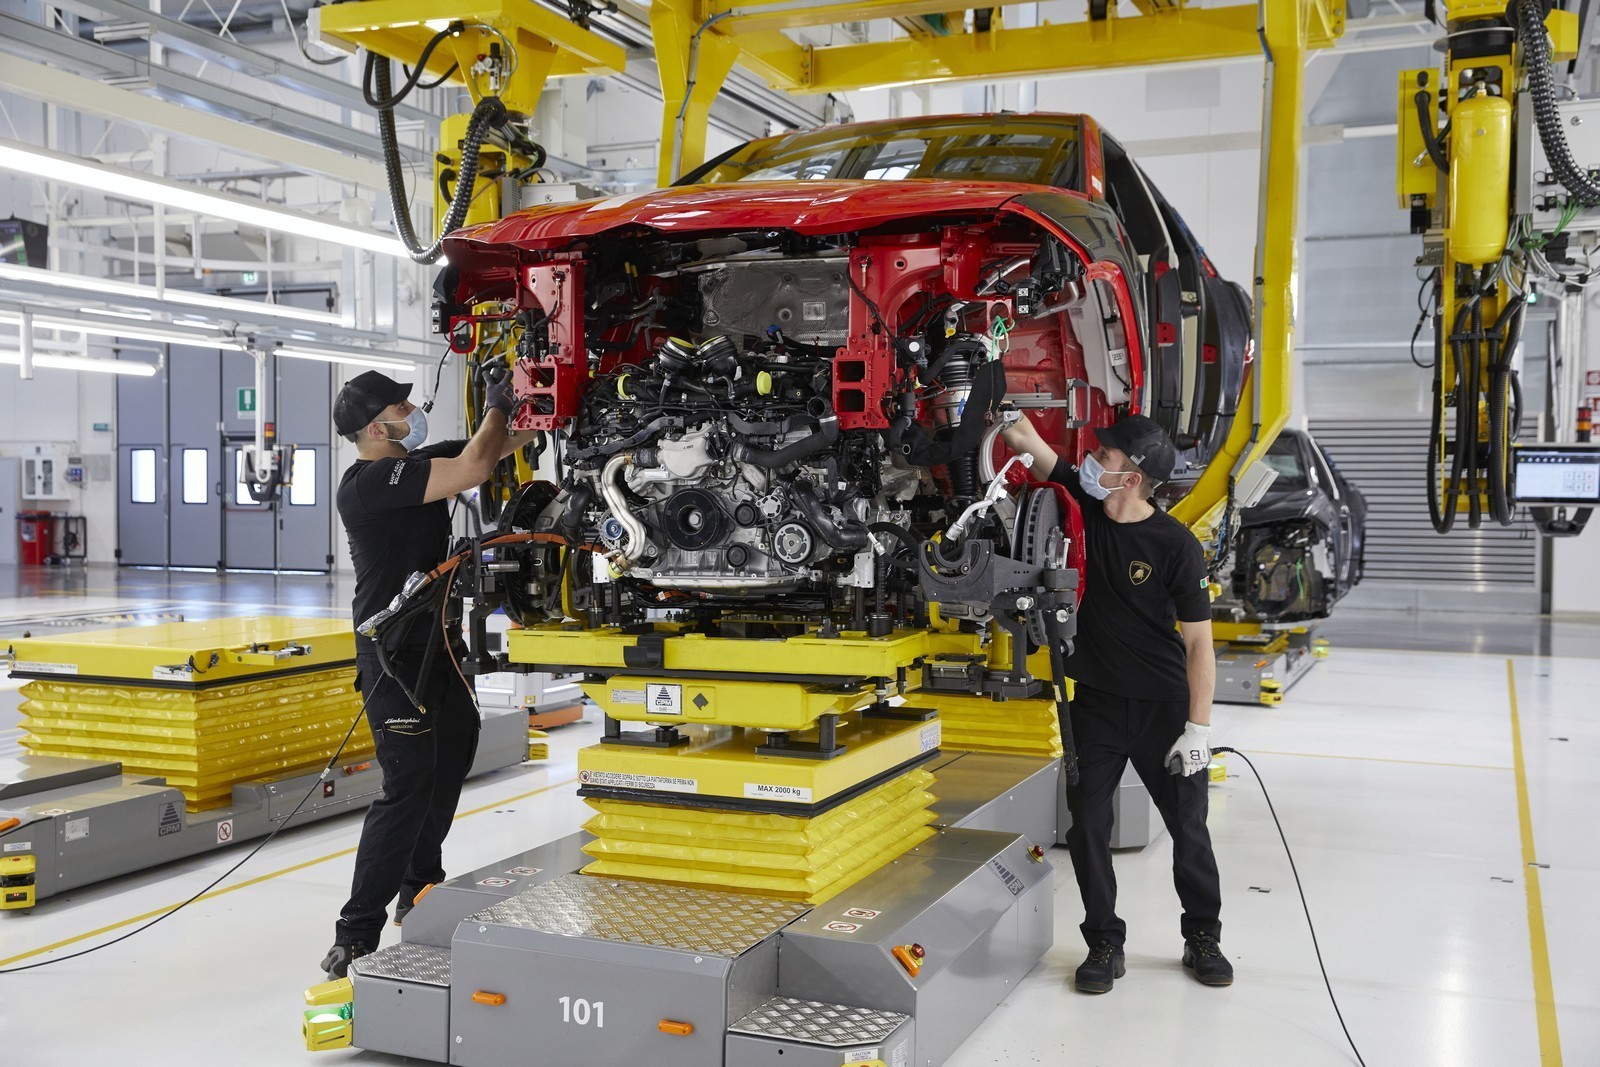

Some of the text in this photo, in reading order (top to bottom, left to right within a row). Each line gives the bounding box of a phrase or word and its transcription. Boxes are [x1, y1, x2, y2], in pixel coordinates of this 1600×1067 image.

[606, 772, 622, 780] ACCEDERE
[757, 785, 774, 793] MAX
[775, 786, 791, 794] 2000
[792, 788, 801, 796] kg
[160, 823, 181, 836] CPM
[559, 996, 604, 1028] 101
